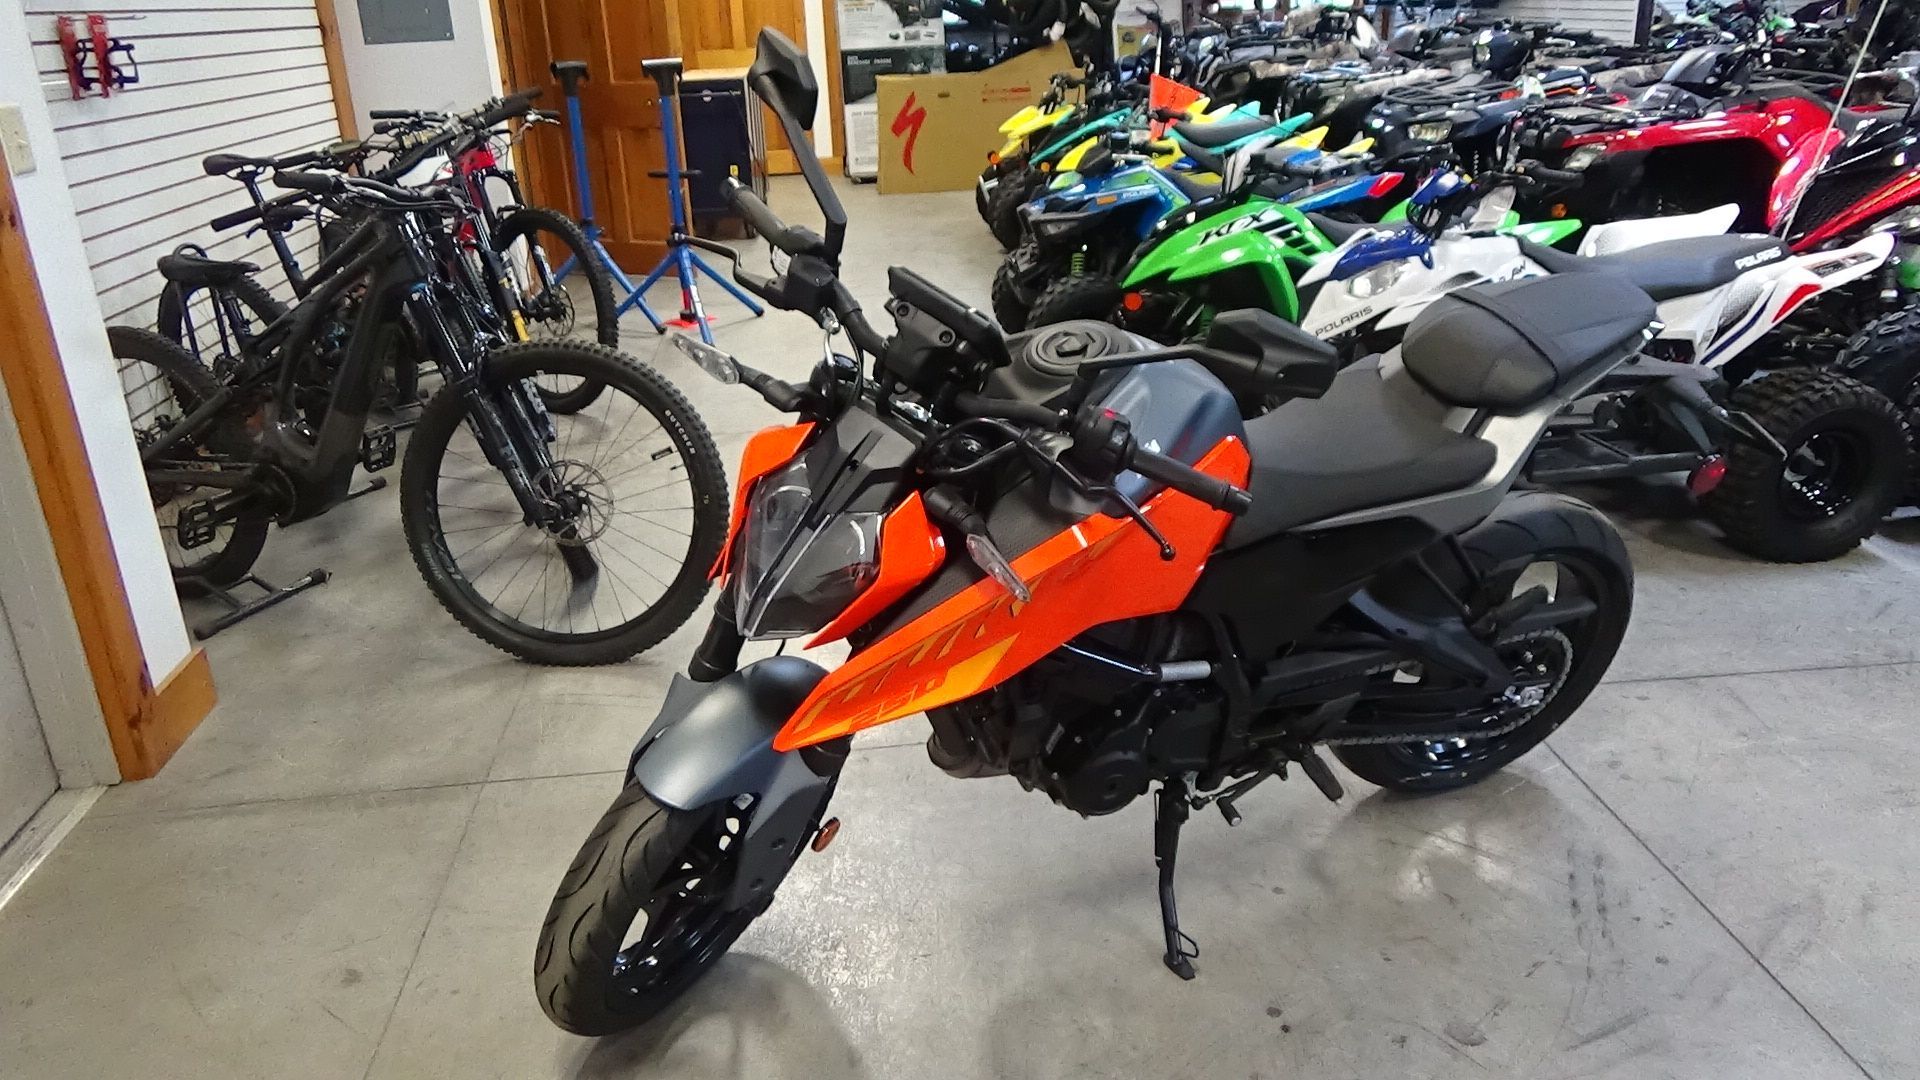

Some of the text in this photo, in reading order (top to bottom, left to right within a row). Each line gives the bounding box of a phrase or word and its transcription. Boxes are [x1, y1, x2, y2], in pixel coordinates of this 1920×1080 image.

[1198, 206, 1275, 246] KFX
[1735, 246, 1782, 270] POLARIS
[1315, 305, 1374, 337] POLARIS
